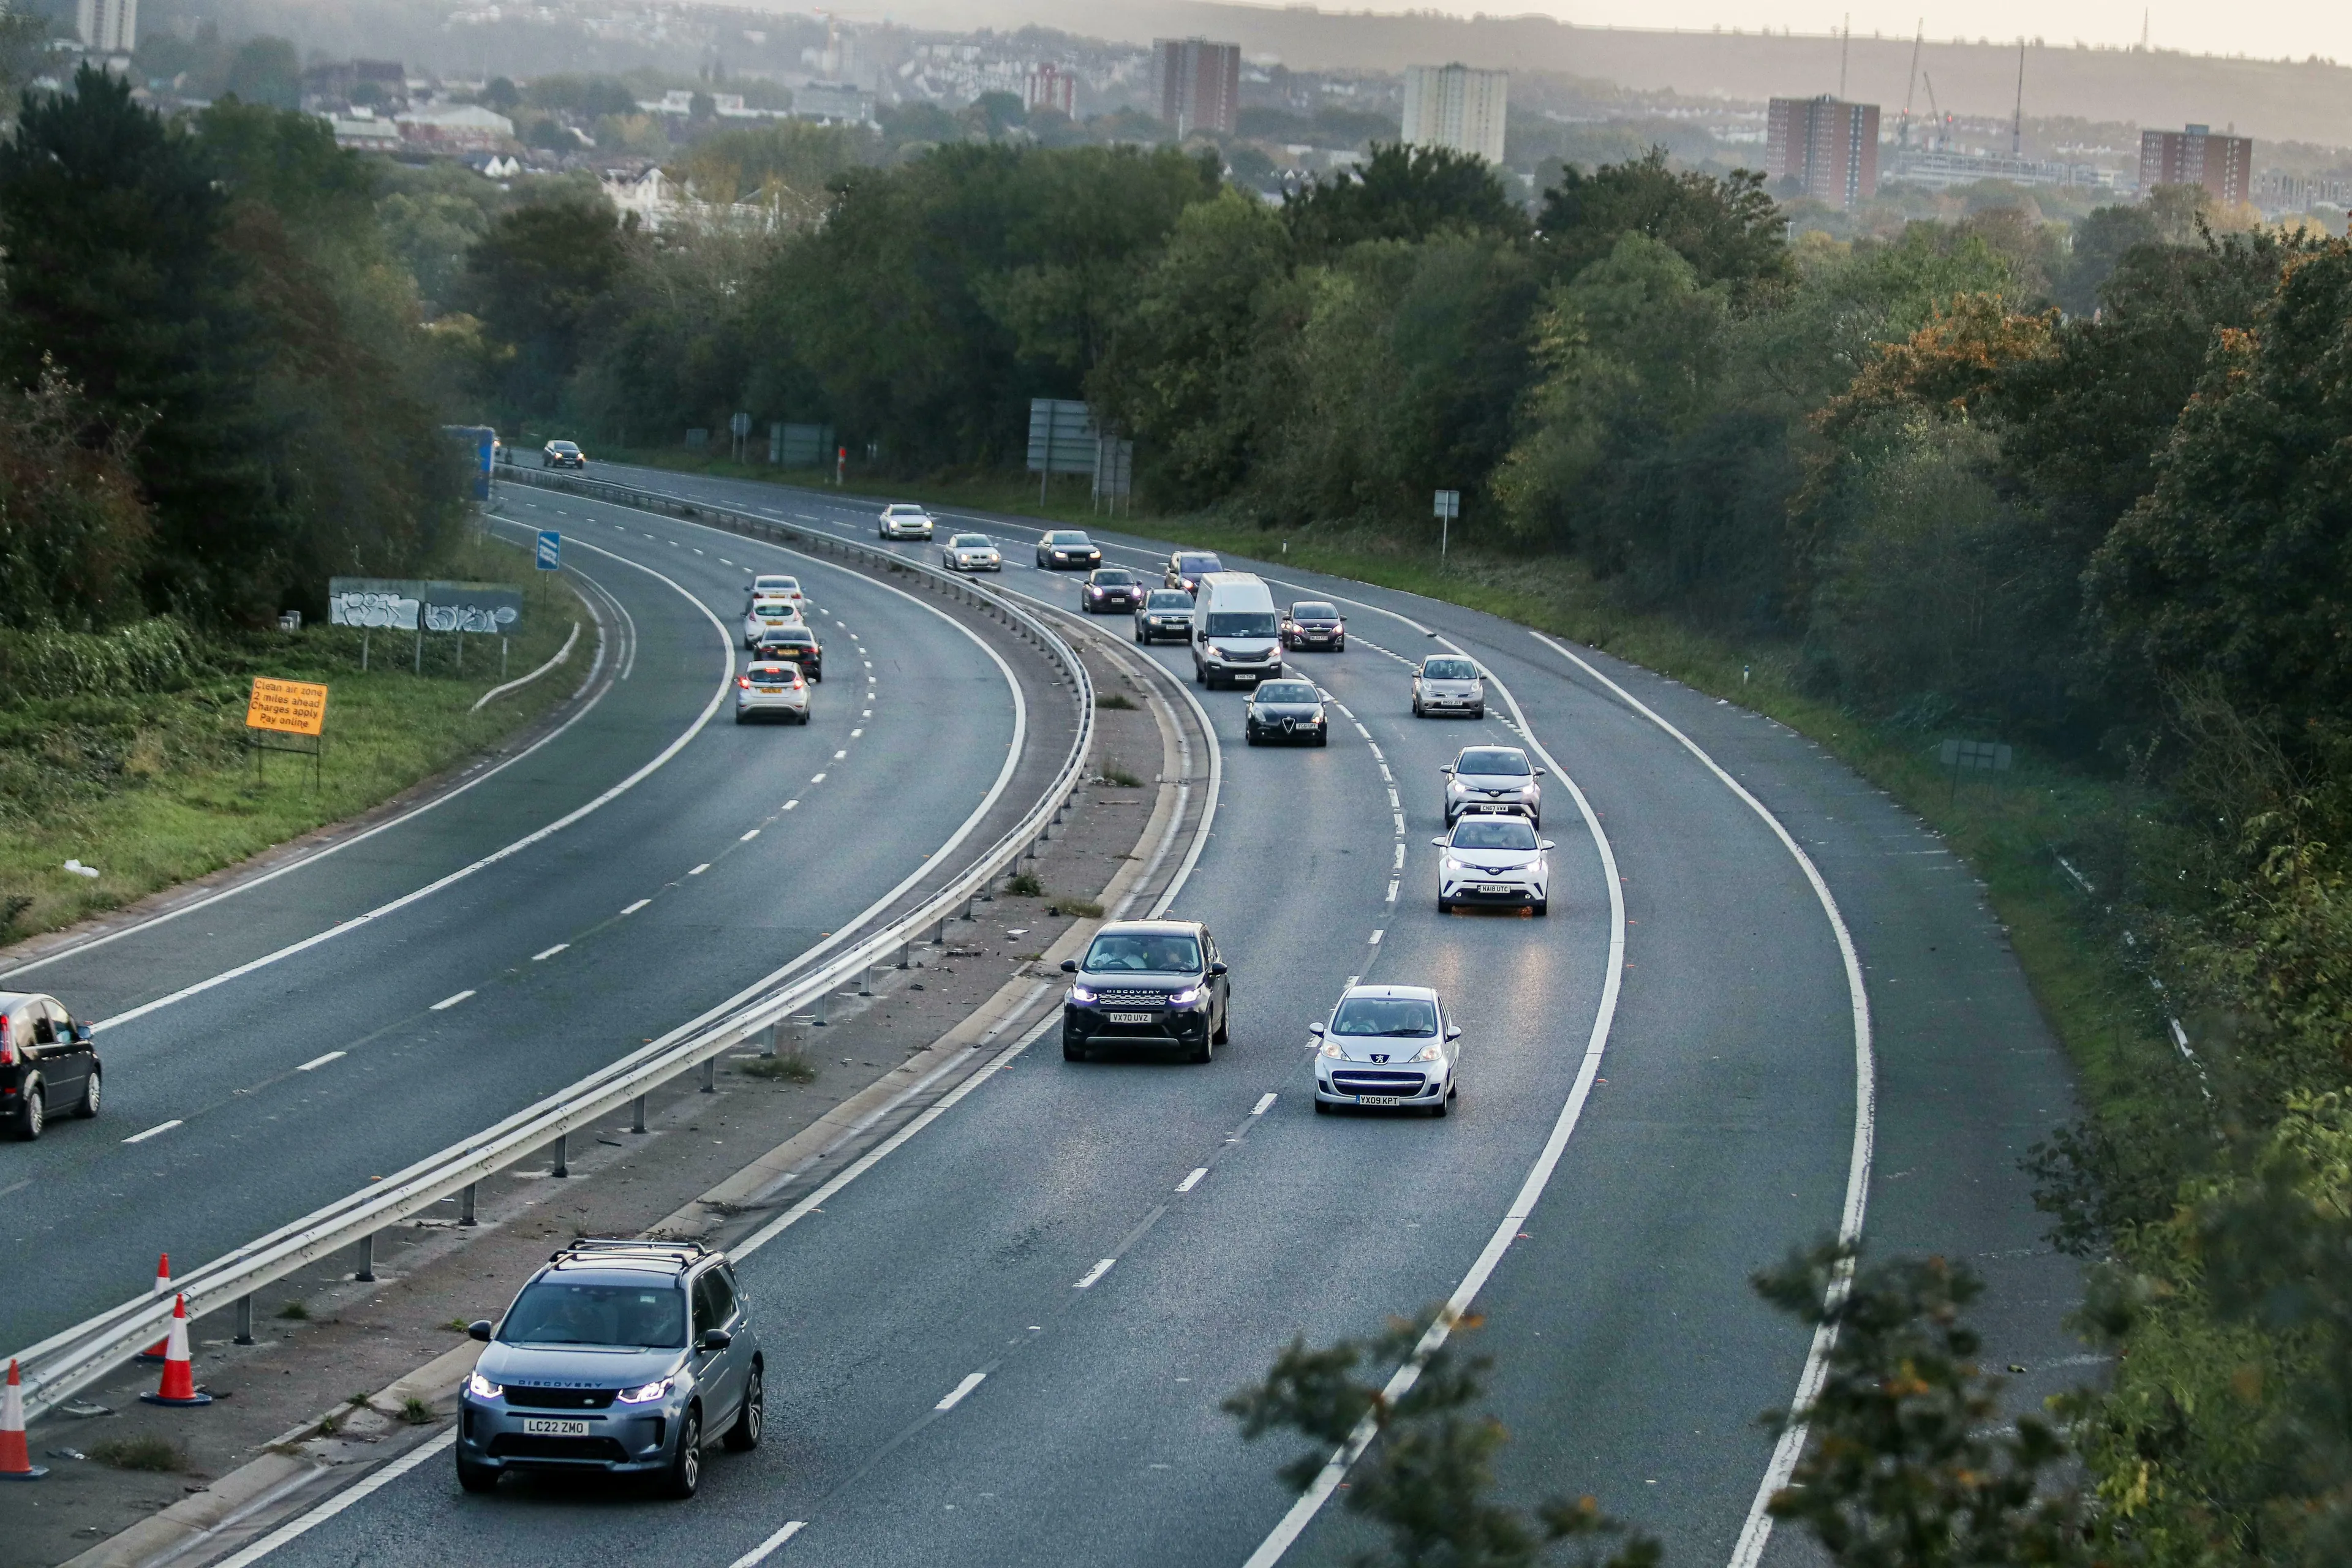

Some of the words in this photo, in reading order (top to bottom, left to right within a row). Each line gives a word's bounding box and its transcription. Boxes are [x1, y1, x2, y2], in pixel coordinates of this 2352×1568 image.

[255, 680, 282, 691] Clean
[301, 688, 322, 697] zone
[254, 692, 260, 700] 2
[263, 694, 288, 704] miles
[292, 697, 320, 708] ahead
[251, 701, 289, 714] Charges
[293, 708, 318, 719] apply
[260, 713, 276, 724] Pay
[279, 717, 309, 727] online
[529, 1420, 559, 1432] LC22
[562, 1422, 583, 1433] ZMO
